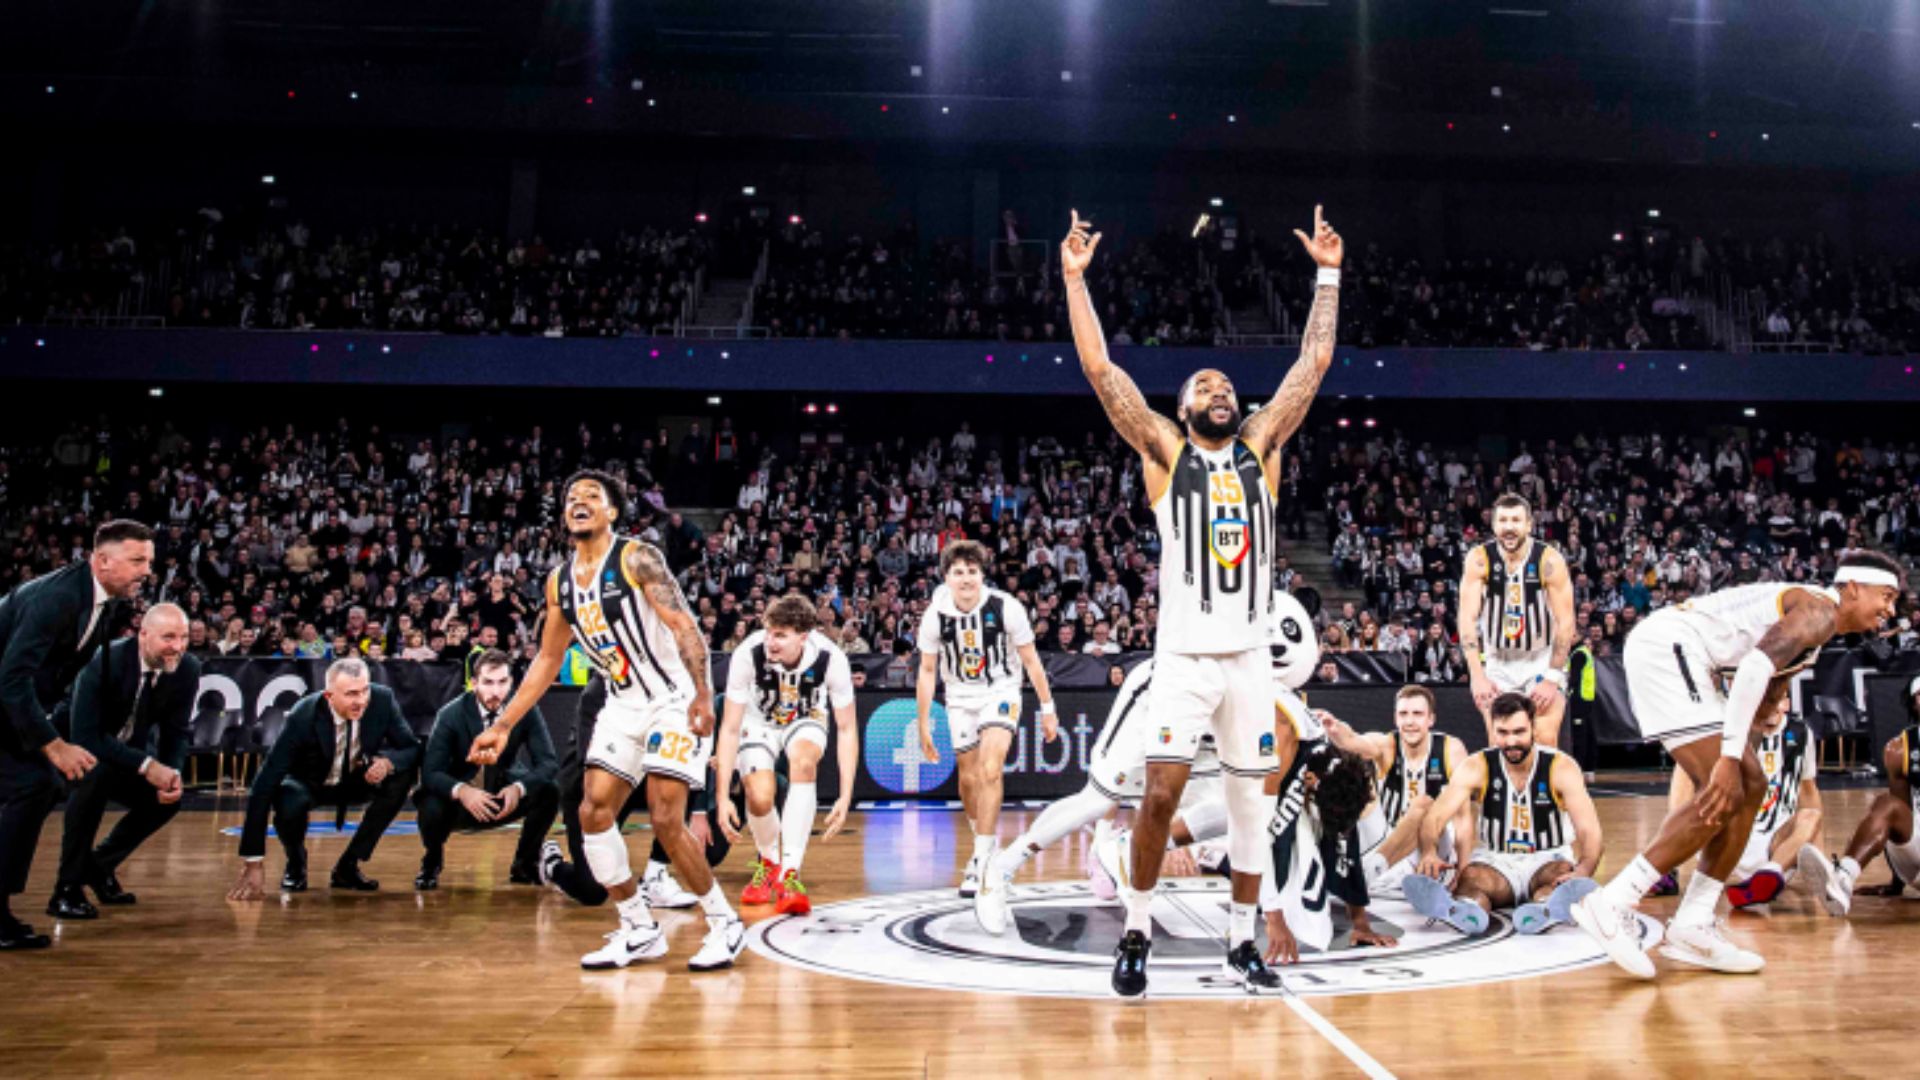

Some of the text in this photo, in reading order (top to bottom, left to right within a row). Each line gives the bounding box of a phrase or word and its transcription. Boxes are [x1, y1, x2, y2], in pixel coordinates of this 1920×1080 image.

[1218, 530, 1241, 546] BT
[577, 602, 608, 635] 32
[660, 731, 693, 764] 32
[1512, 805, 1530, 832] 15
